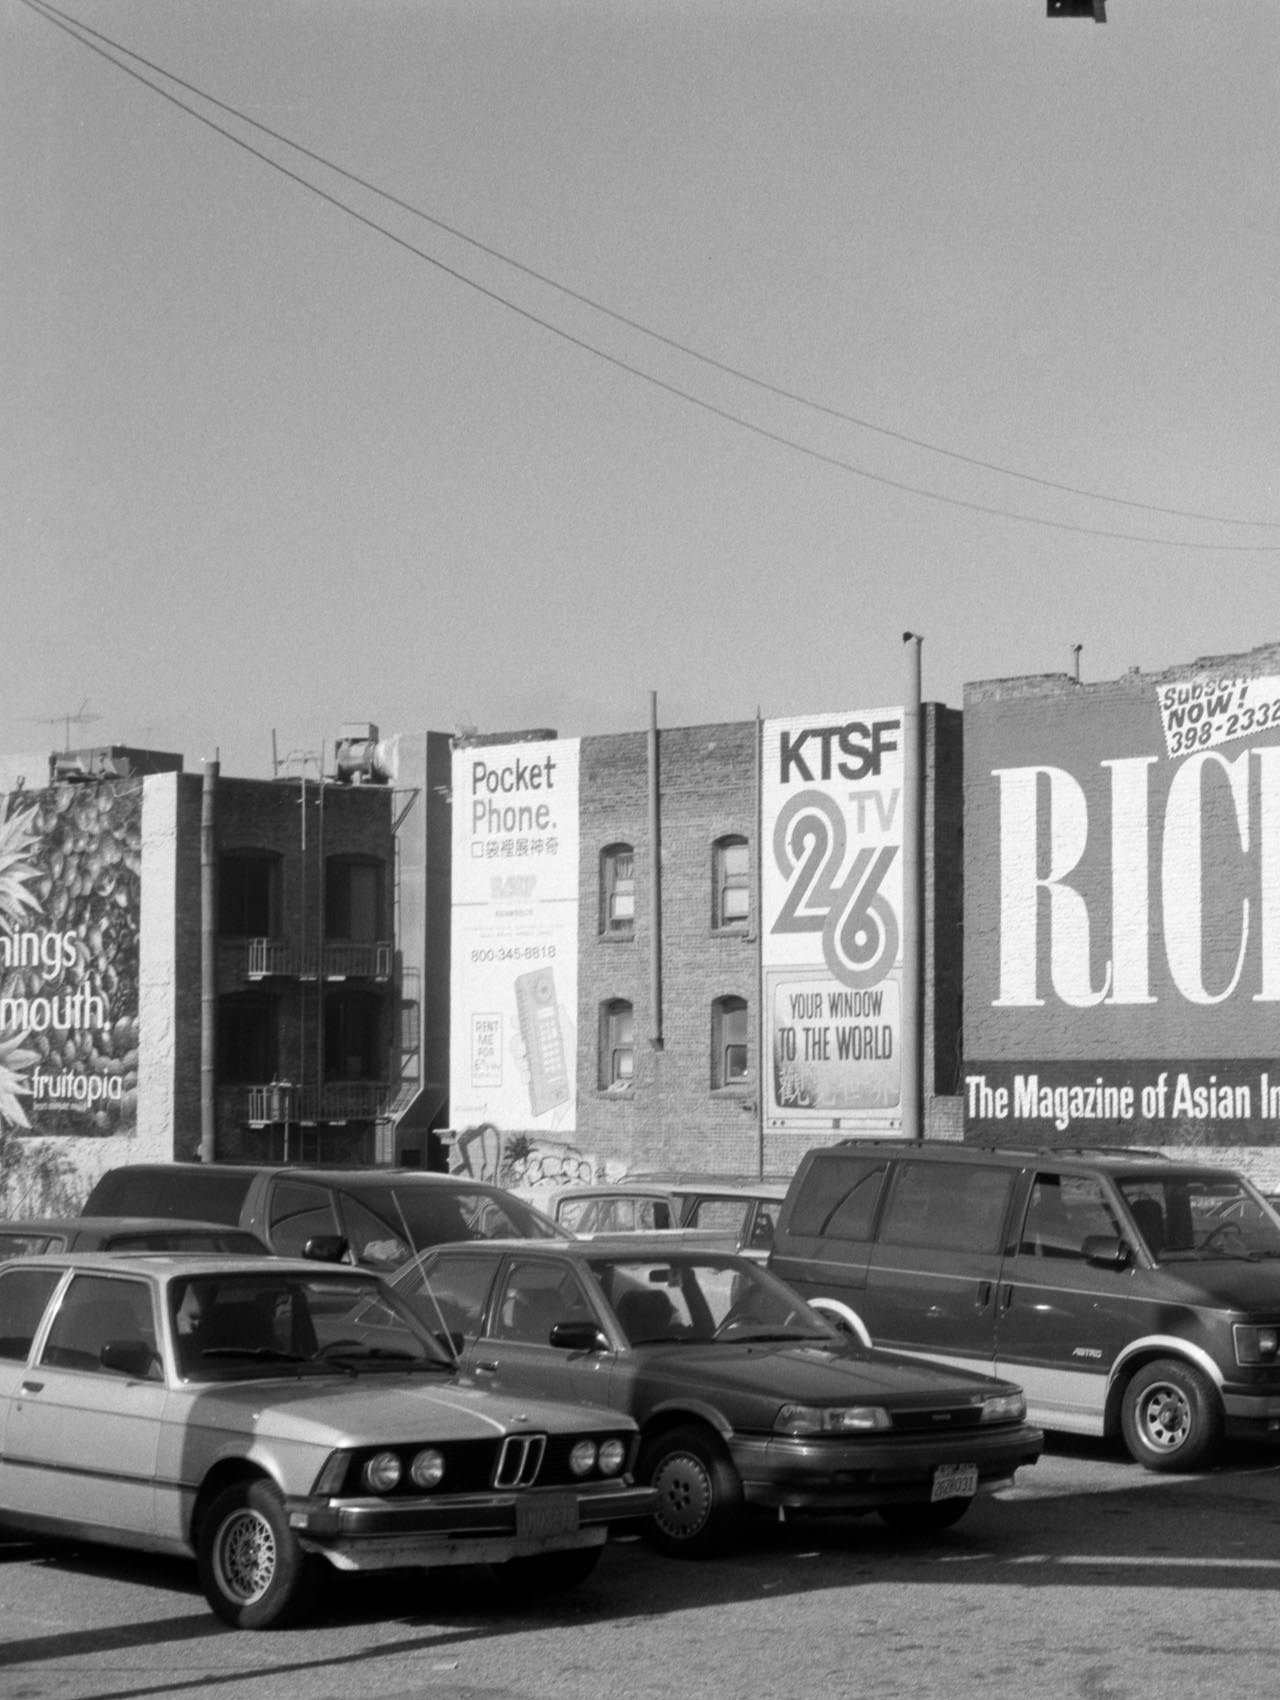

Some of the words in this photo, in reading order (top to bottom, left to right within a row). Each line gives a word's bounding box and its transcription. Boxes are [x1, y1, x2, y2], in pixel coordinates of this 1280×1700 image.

[779, 719, 901, 784] KTSF
[472, 755, 557, 796] Pocket
[472, 797, 557, 835] Phone.
[847, 787, 901, 834] TV
[769, 788, 901, 991] 26
[789, 991, 823, 1020] YOUR
[827, 990, 884, 1019] WINDOW
[778, 1026, 797, 1062] TO
[802, 1026, 831, 1062] THE
[835, 1024, 893, 1061] WORLD
[31, 1065, 123, 1109] fruitopia
[964, 1075, 1009, 1119] The
[1013, 1074, 1135, 1131] Magazine
[1141, 1072, 1169, 1119] of
[1171, 1072, 1251, 1119] Asian
